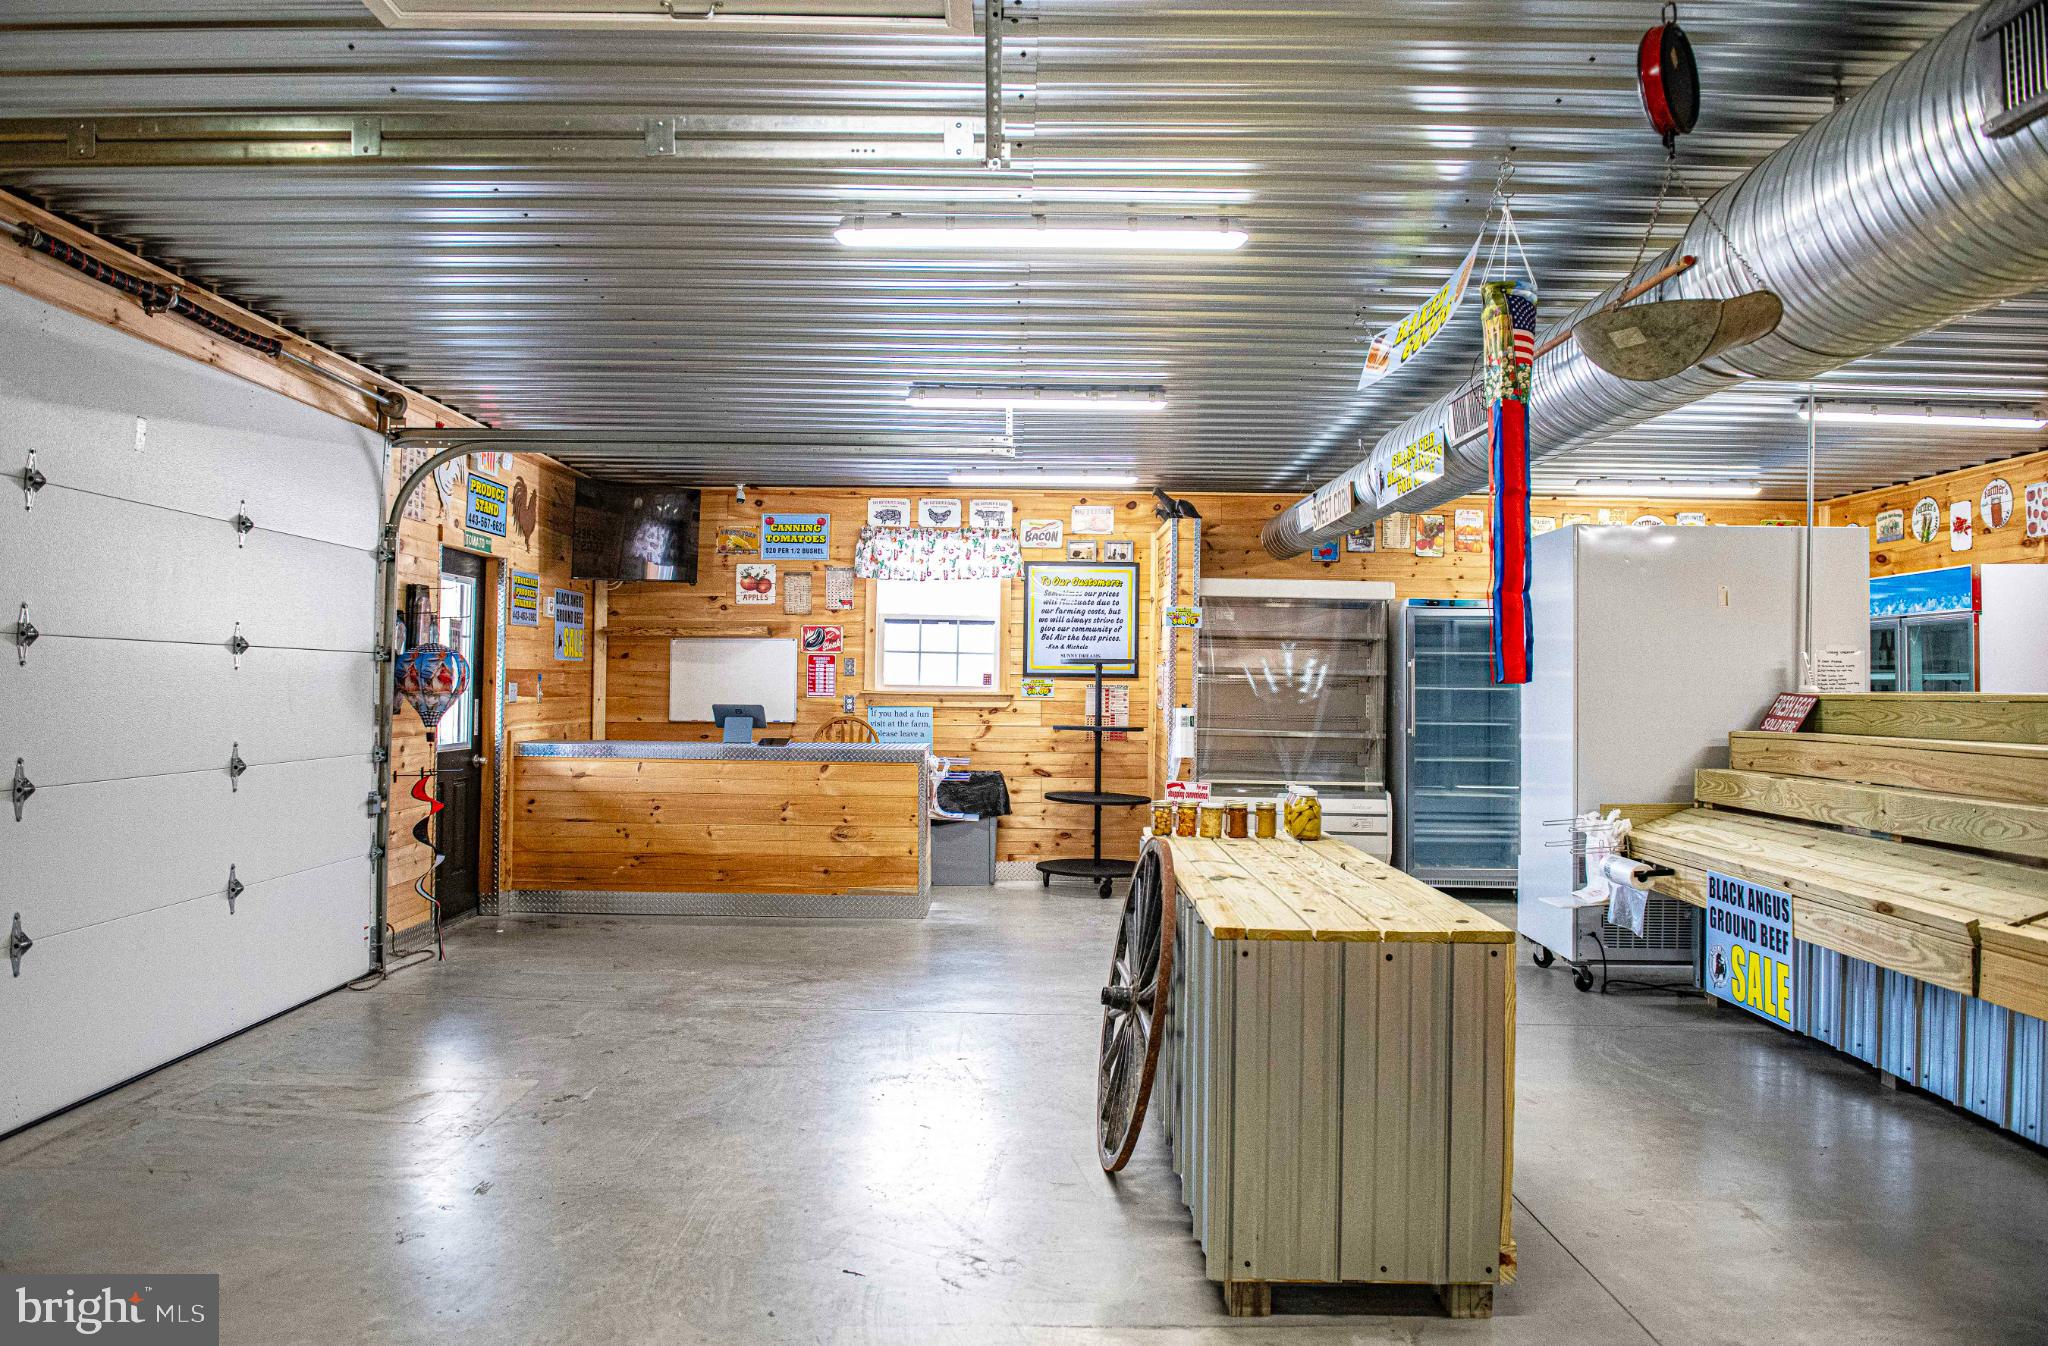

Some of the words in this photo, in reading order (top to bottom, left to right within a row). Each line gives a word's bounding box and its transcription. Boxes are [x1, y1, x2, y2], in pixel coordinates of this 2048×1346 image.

[1393, 283, 1451, 348] BAKED
[1401, 295, 1455, 363] GOODS
[1392, 443, 1416, 470] GRASS
[1418, 431, 1435, 452] FED
[1387, 461, 1411, 488] BLAK
[470, 479, 506, 503] PRODUCE
[1397, 476, 1412, 496] FOR
[475, 497, 500, 518] STAND
[770, 524, 822, 532] CANNING
[766, 534, 826, 544] TOMATOES
[1025, 530, 1058, 542] BACON
[1041, 576, 1050, 586] To
[1052, 576, 1071, 586] Our
[1072, 577, 1123, 588] Customers:
[556, 591, 570, 606] BLACK
[556, 609, 573, 623] GROUND
[574, 610, 584, 624] BEEF
[1055, 608, 1086, 616] farming
[1066, 617, 1092, 625] always
[1040, 625, 1055, 633] give
[1072, 626, 1112, 634] community
[564, 626, 583, 658] SALE
[1097, 635, 1120, 643] prices.
[911, 720, 930, 728] farm,
[1761, 718, 1782, 730] SOLD
[1168, 790, 1184, 799] shopping
[1708, 876, 1744, 909] BLACK
[1747, 888, 1790, 924] ANGUS
[1710, 906, 1756, 944] GROUND
[1760, 922, 1789, 955] BEEF
[1731, 944, 1790, 1024] SALE
